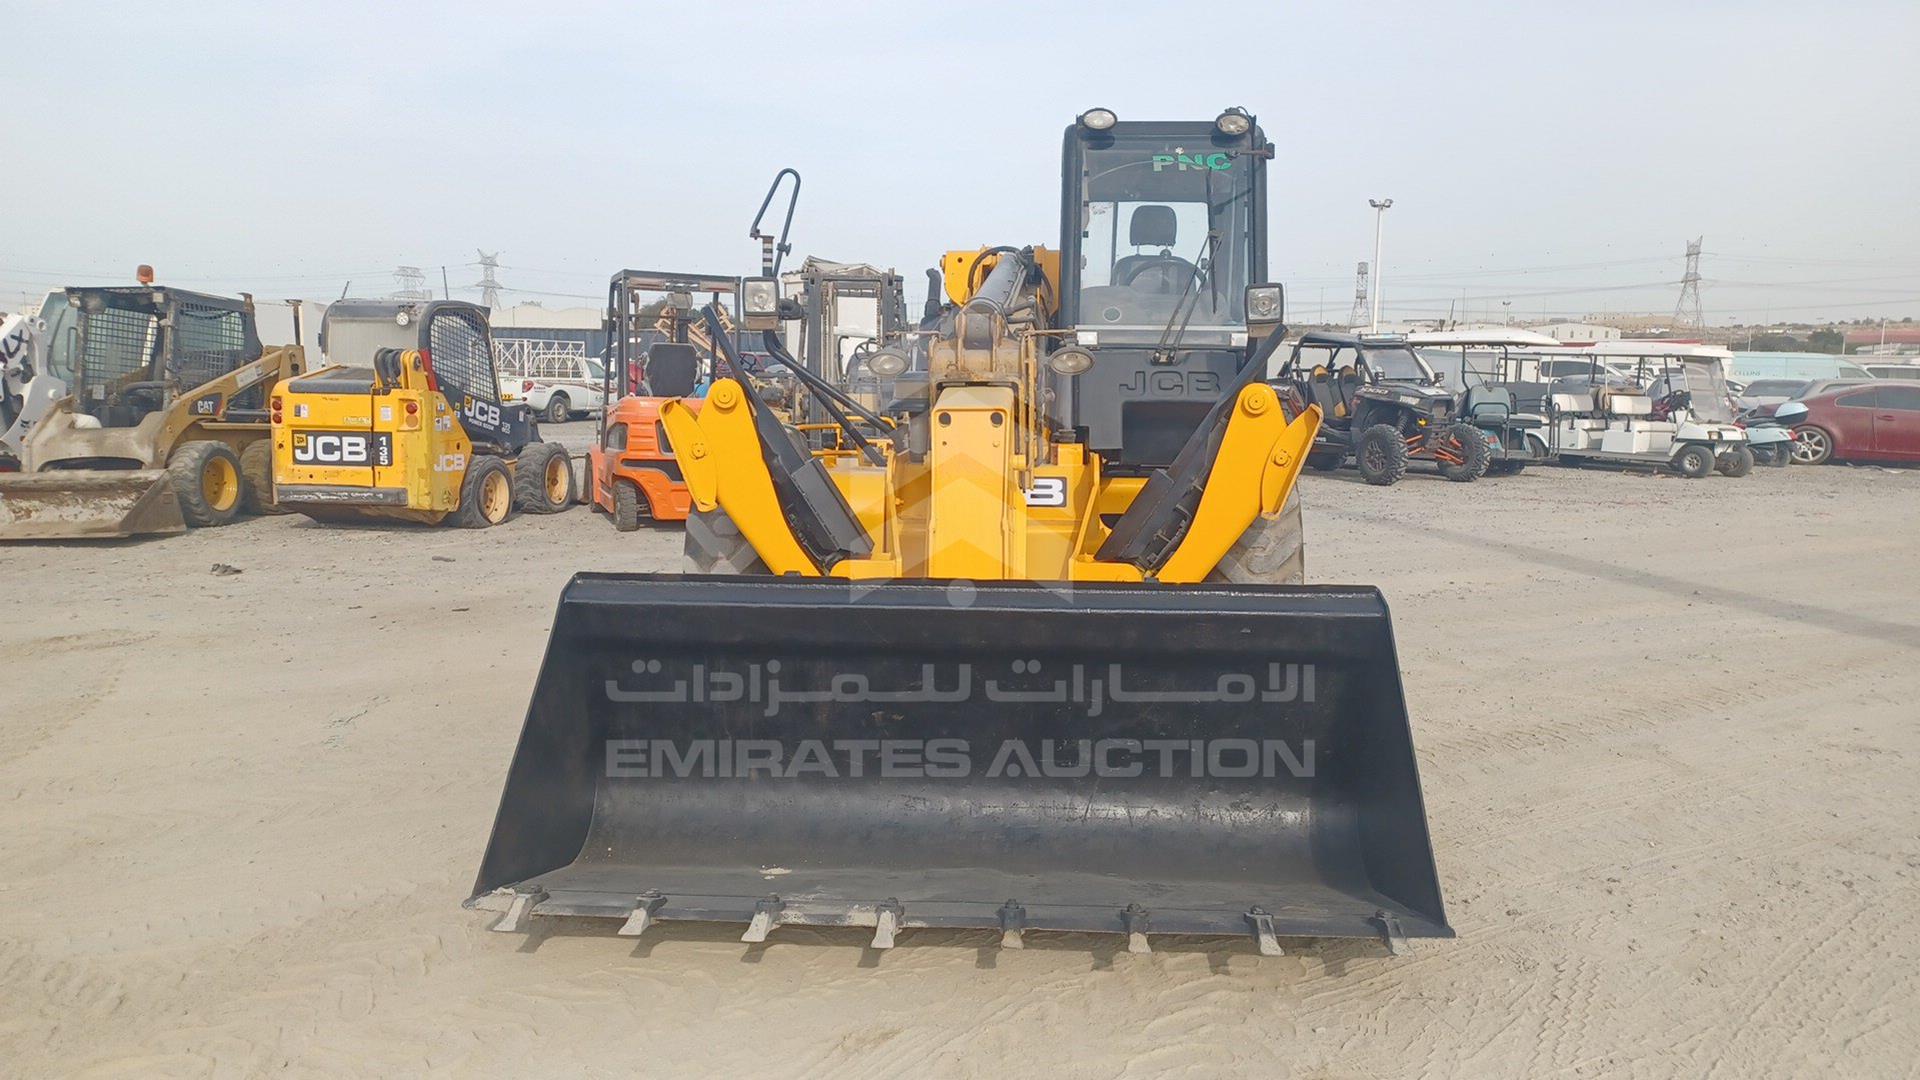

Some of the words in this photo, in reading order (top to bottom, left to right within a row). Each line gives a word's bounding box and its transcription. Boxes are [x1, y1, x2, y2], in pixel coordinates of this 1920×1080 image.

[1152, 153, 1233, 172] PNC
[1119, 370, 1221, 398] JCB
[197, 400, 214, 414] CAT
[464, 397, 500, 427] JCB
[294, 435, 367, 462] JCB
[379, 436, 389, 466] 135
[433, 453, 465, 472] JCB
